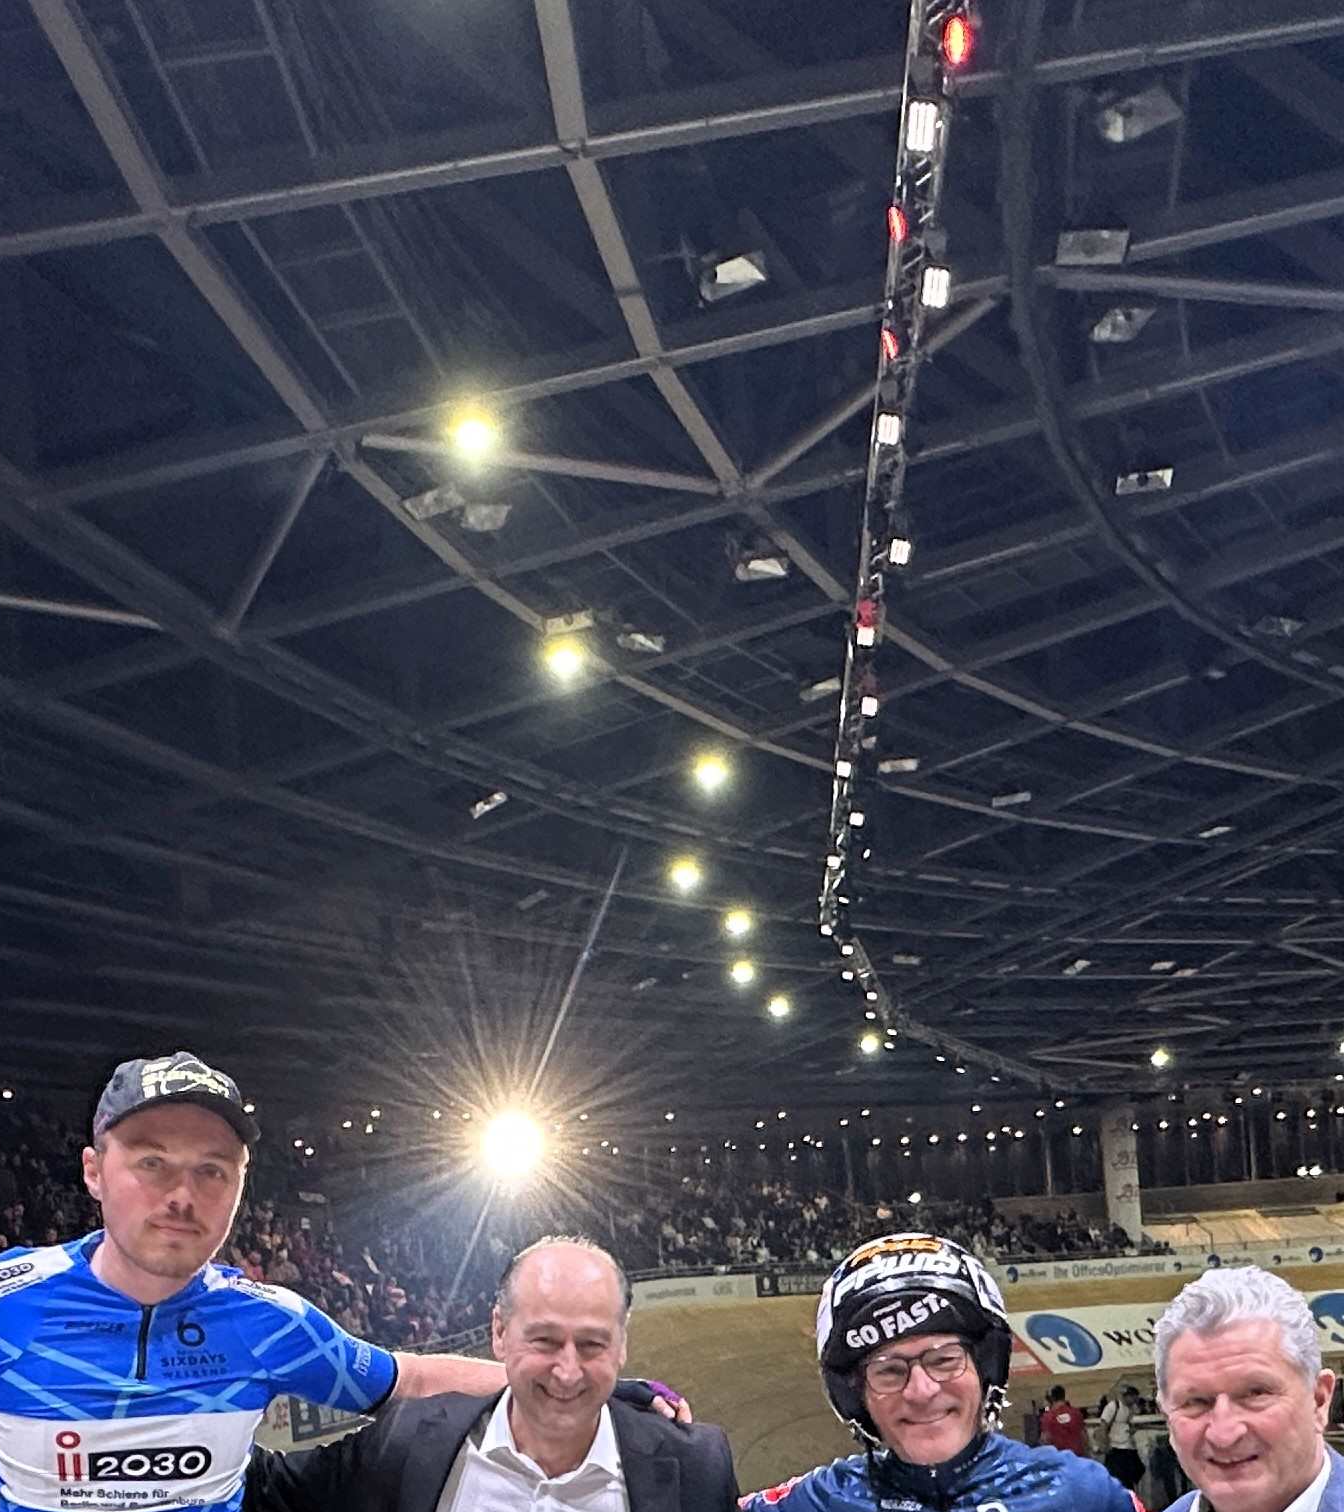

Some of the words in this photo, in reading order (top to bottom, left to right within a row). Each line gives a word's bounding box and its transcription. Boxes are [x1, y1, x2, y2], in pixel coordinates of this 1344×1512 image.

[846, 1324, 880, 1349] GO
[160, 1352, 227, 1368] SIXDAYS
[60, 1488, 94, 1499] Mehr
[96, 1488, 149, 1500] Schiene
[152, 1487, 170, 1499] für
